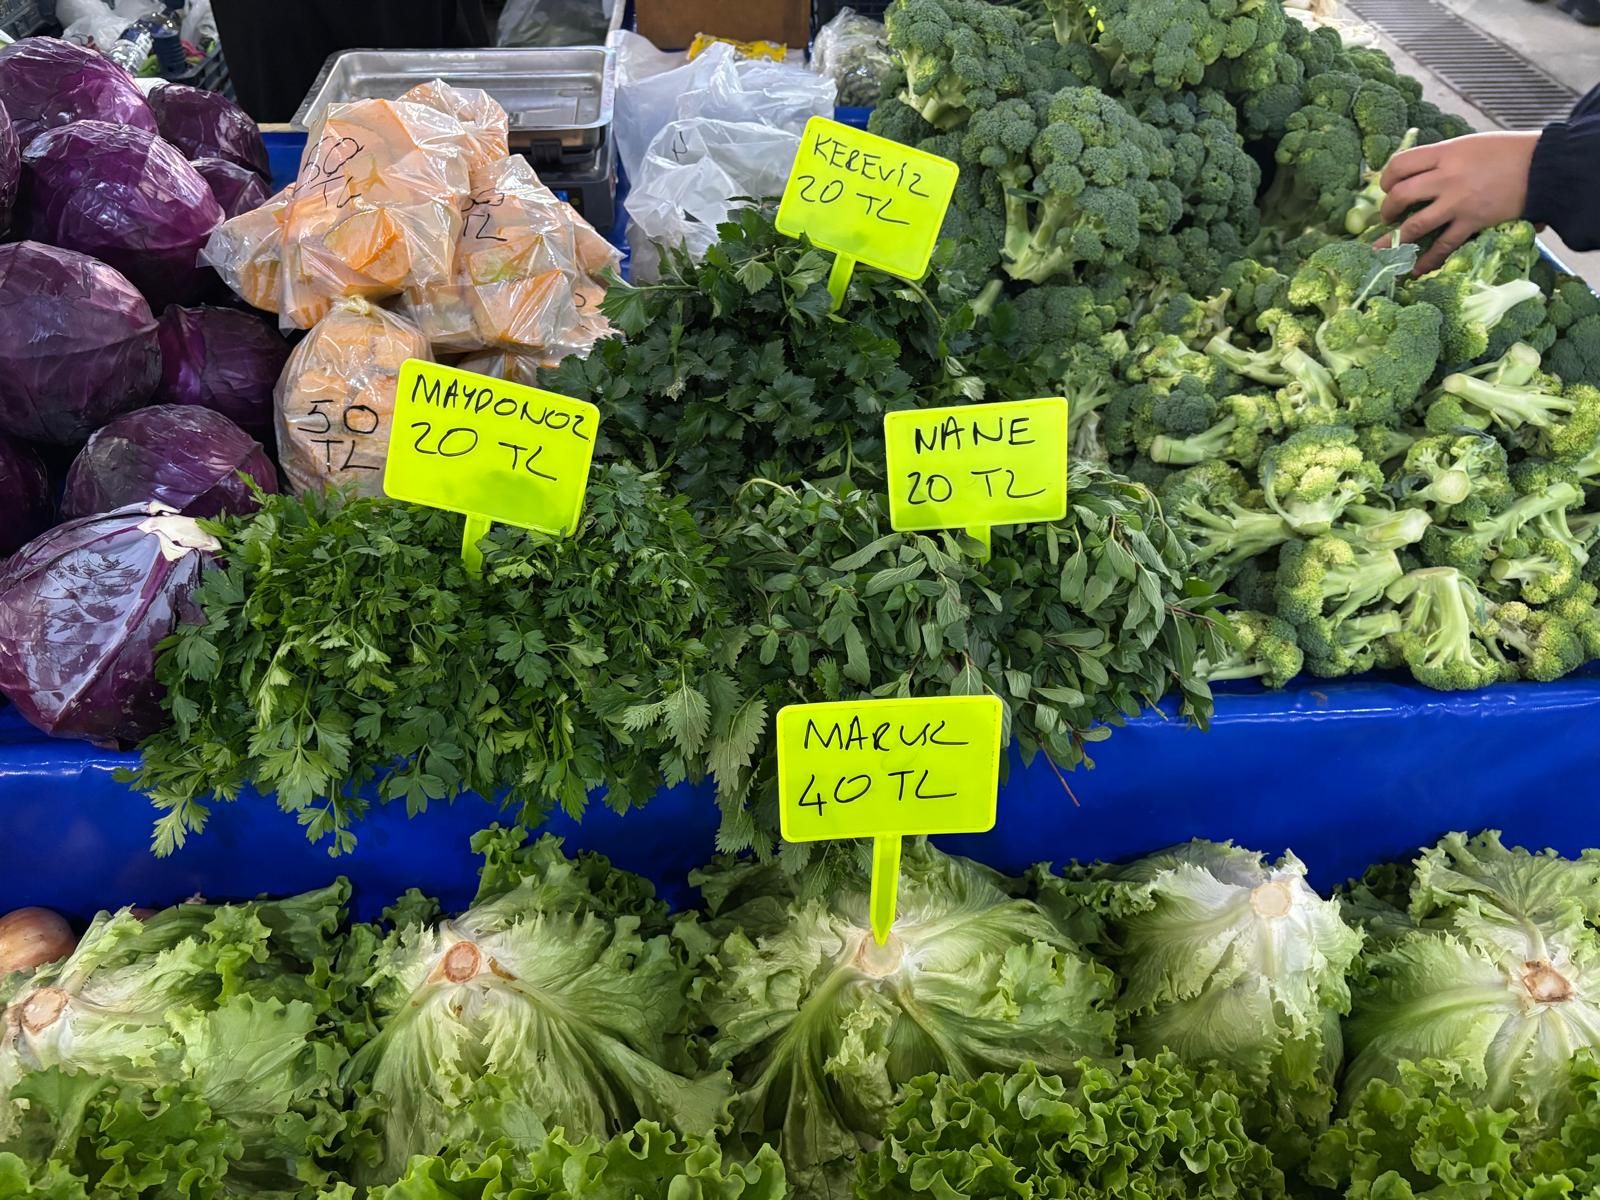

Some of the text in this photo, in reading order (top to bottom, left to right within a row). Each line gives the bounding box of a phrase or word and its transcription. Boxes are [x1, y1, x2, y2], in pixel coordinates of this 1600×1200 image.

[310, 175, 362, 208] TL
[797, 175, 910, 225] 20 TL
[297, 399, 379, 435] 50
[914, 415, 1036, 455] NANE
[310, 438, 381, 473] TL
[411, 421, 558, 481] 20 TL
[907, 467, 1047, 505] 20 TL
[798, 769, 958, 817] 40 TL
